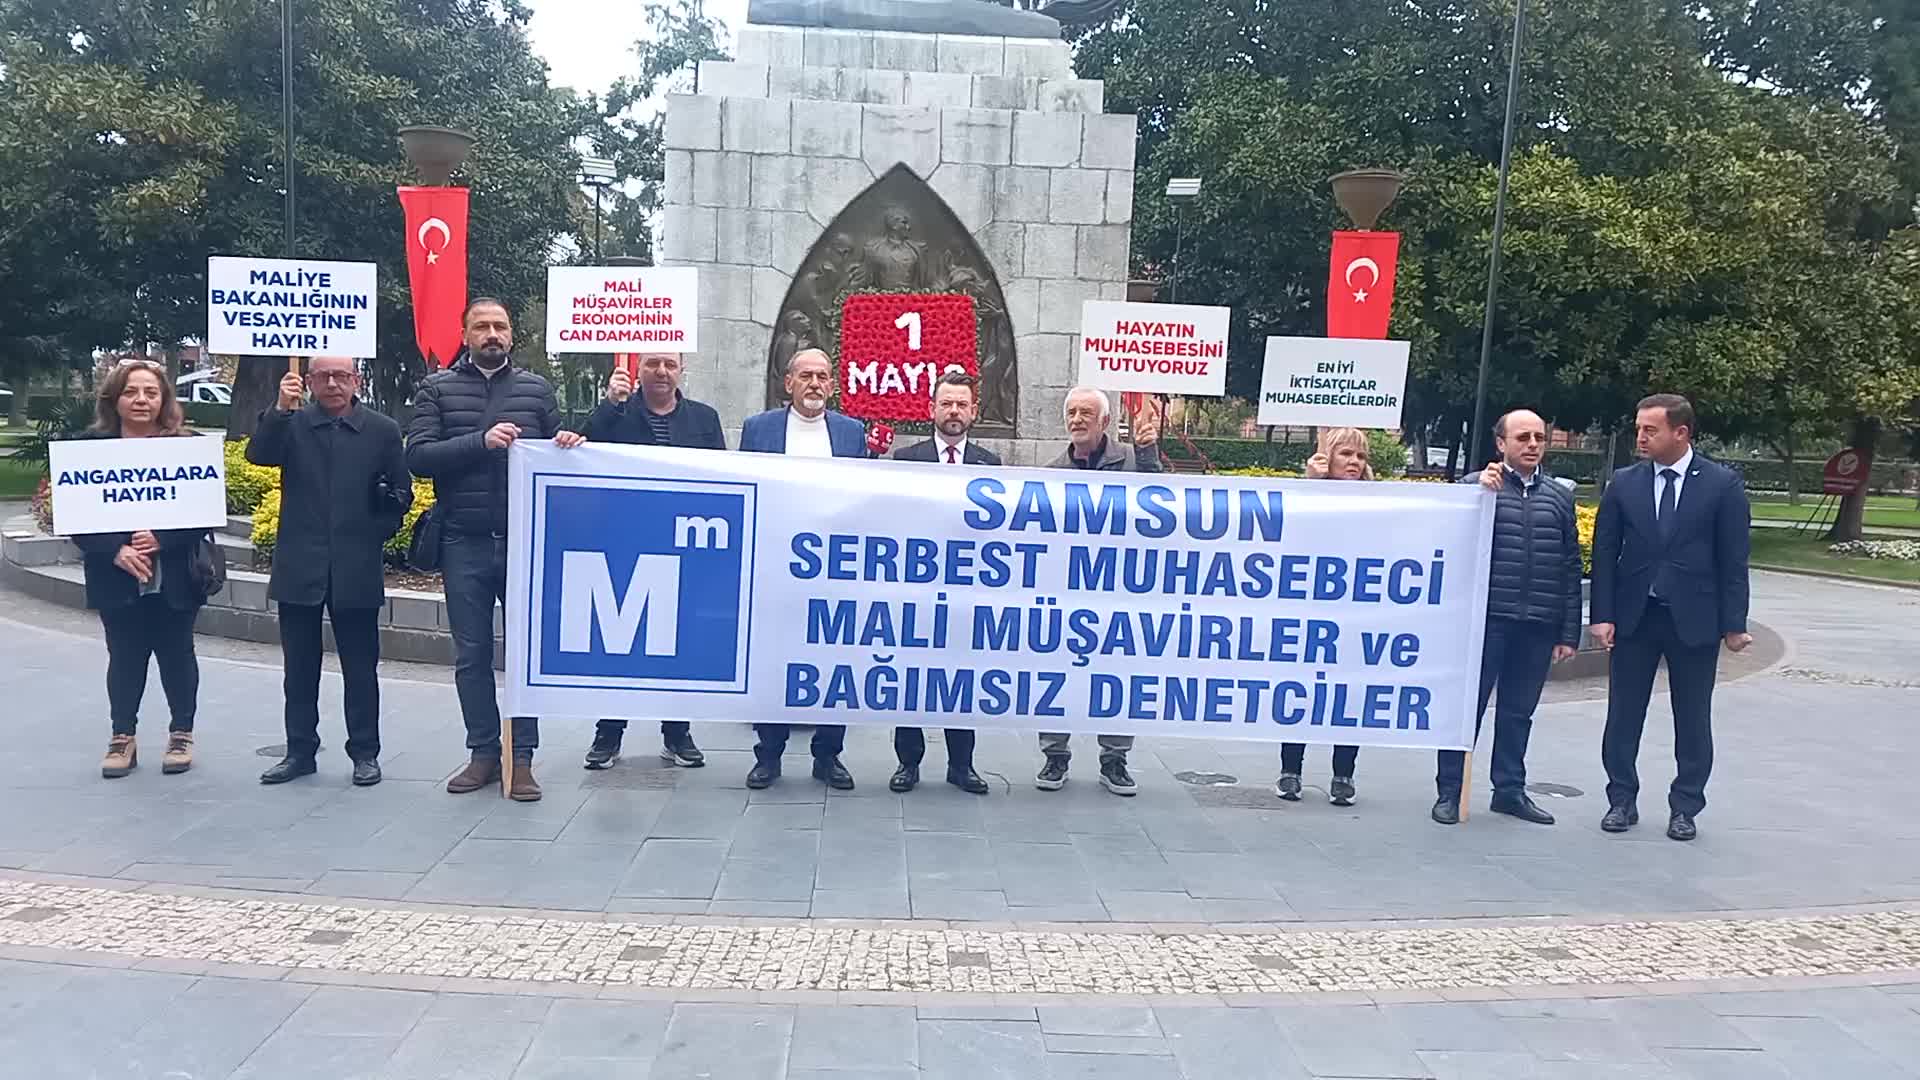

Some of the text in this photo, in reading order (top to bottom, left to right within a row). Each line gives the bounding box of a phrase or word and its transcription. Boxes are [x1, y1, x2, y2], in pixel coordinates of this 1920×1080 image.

[250, 268, 331, 287] MALİYE
[604, 278, 641, 292] MALİ
[211, 289, 367, 309] BAKANLIĞININ
[573, 294, 672, 312] MÜŞAVİRLER
[223, 310, 356, 329] VESAYETİNE
[572, 310, 672, 325] EKONOMİNİN
[560, 330, 684, 341] CAN DAMARIDIR
[894, 312, 921, 350] 1
[1116, 321, 1195, 338] HAYATIN
[252, 333, 317, 349] HAYIR
[1085, 337, 1223, 358] MUHASEBESİNİ
[1098, 357, 1208, 375] TUTUYORUZ
[1317, 360, 1354, 374] EN İYİ
[848, 361, 965, 397] MAYI
[1290, 375, 1376, 392] İKTİSATÇILAR
[1265, 392, 1397, 407] MUHASEBECİLERDİR
[58, 465, 218, 486] ANGARYALARA
[103, 486, 166, 503] HAYIR
[963, 477, 1284, 542] SAMSUN
[789, 532, 1444, 605] SERBEST MUHASEBECİ
[806, 592, 1420, 668] MALİ MÜŞAVİRLER ve
[785, 653, 1432, 730] BAĞIMSIZ DENETCİLER
